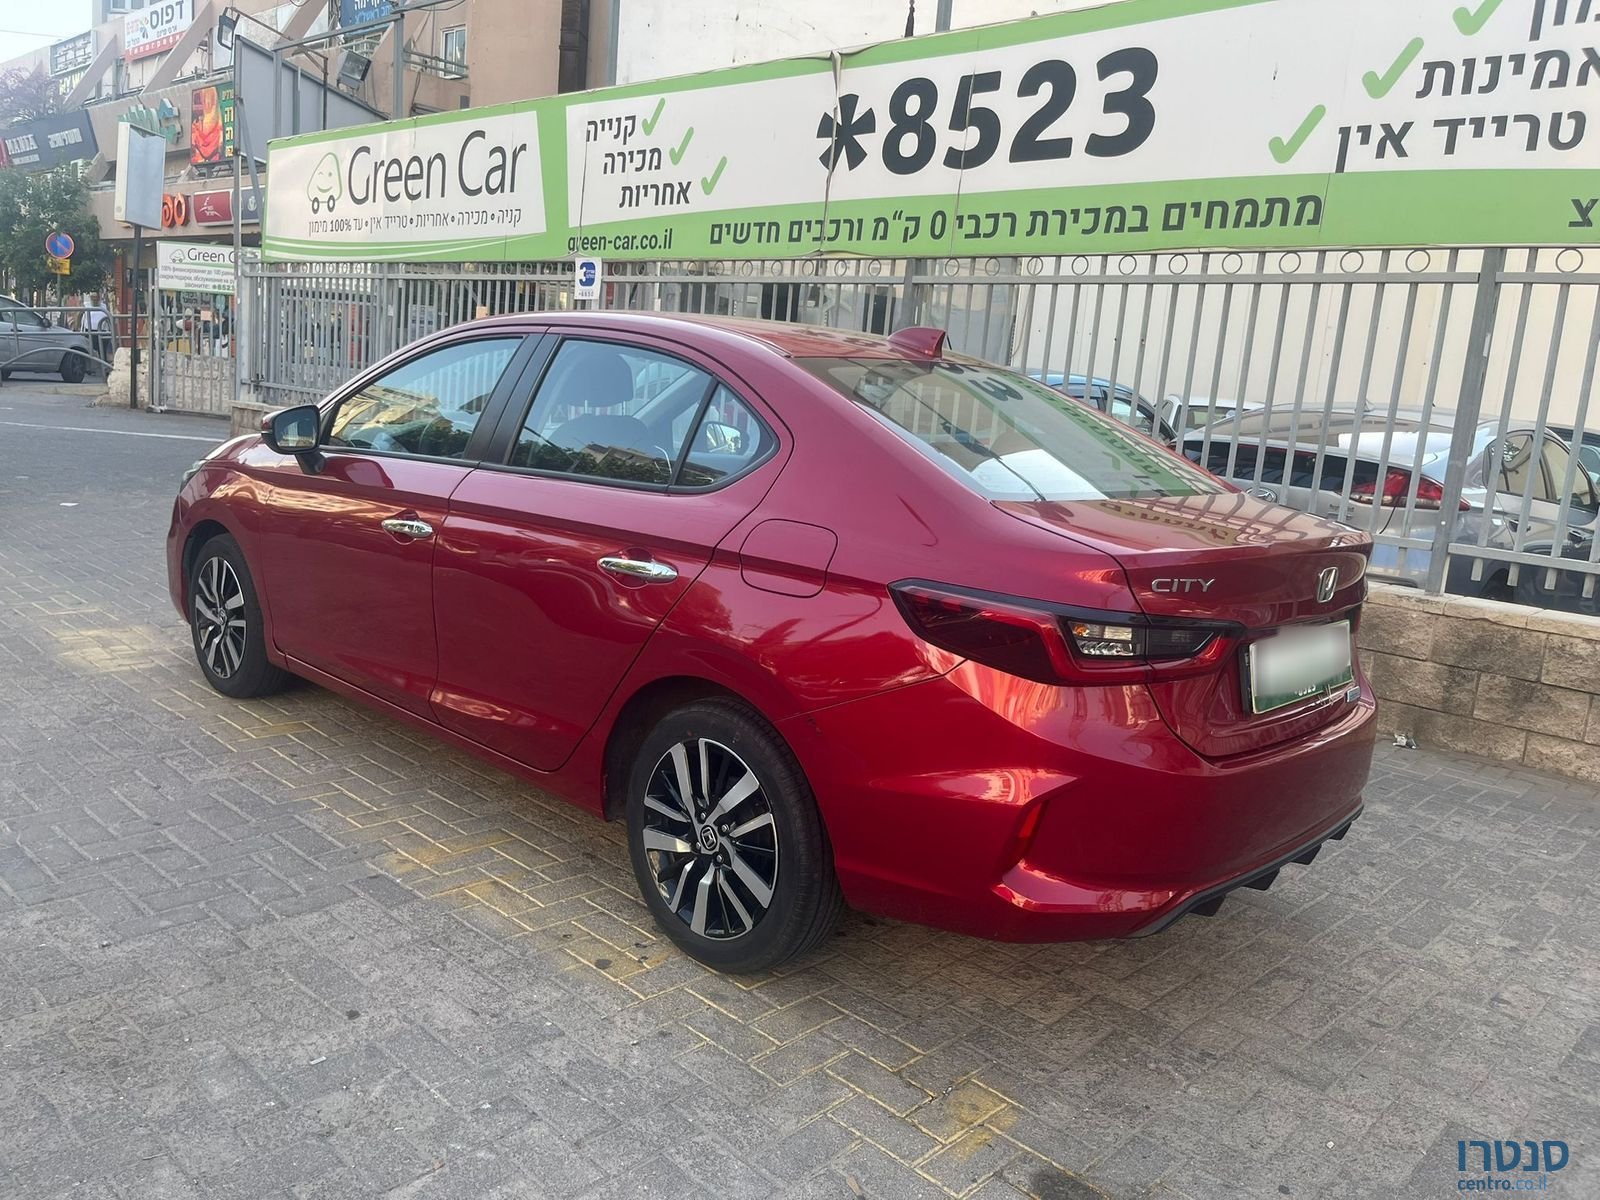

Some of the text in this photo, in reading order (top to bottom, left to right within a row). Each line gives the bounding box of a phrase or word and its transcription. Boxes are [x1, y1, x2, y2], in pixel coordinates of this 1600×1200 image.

[149, 0, 184, 30] דפוס
[586, 116, 636, 146] קנייה
[1335, 110, 1587, 174] טרייד אין
[348, 130, 527, 205] Green Car
[603, 147, 662, 175] מכירה
[619, 181, 692, 208] אחריות
[308, 208, 522, 237] קניה מכירה אחריות טרייד אין עד 100% מימון
[930, 210, 947, 240] 0
[955, 212, 1017, 240] רכבי
[1025, 206, 1149, 237] במכירת
[1161, 195, 1323, 232] מתמחים
[709, 221, 780, 245] חדשים
[788, 218, 865, 243] ורכבים
[187, 247, 226, 263] Green
[579, 262, 596, 287] 3
[1151, 578, 1216, 593] CITY
